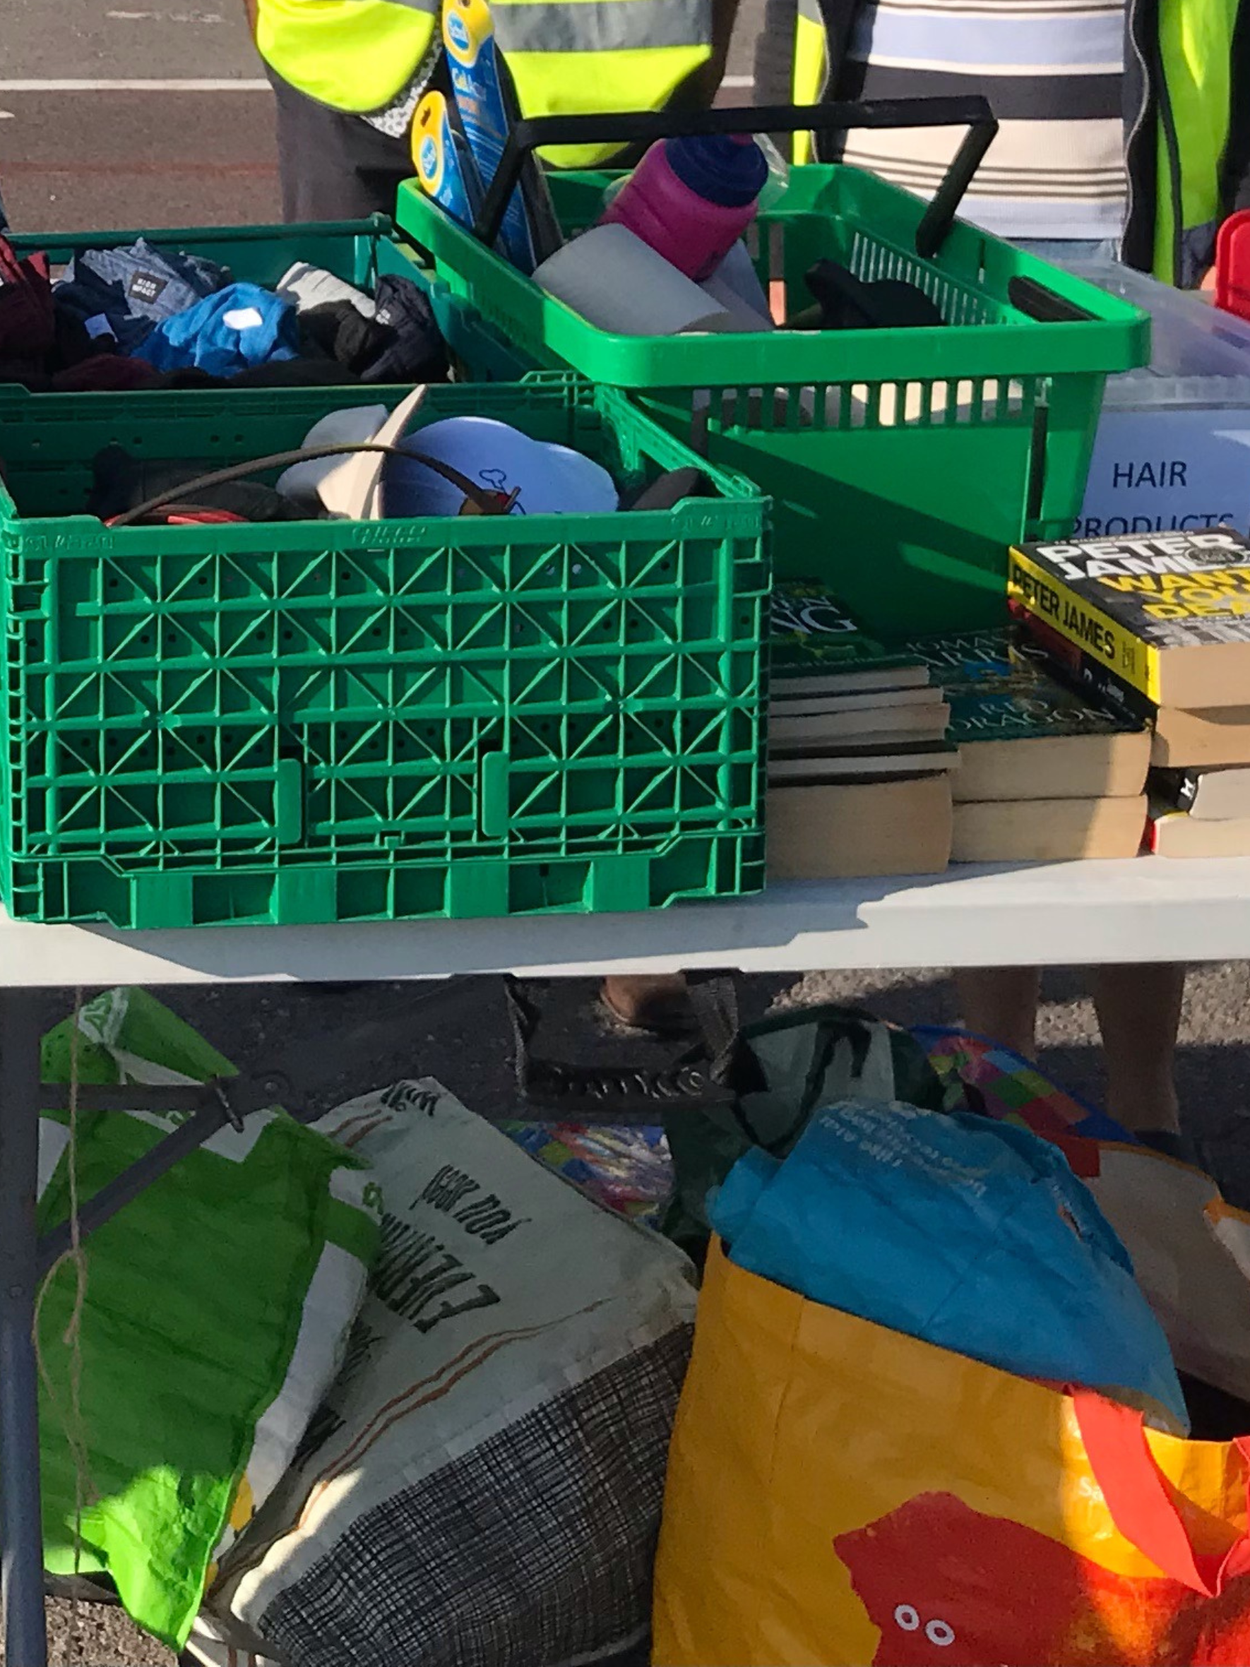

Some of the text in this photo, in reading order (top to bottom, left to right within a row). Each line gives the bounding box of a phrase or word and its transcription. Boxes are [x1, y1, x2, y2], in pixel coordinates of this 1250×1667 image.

[1112, 460, 1188, 488] HAIR
[1036, 533, 1246, 564] PETER
[1058, 550, 1248, 581] JAM
[770, 605, 859, 635] NG
[1013, 564, 1060, 622] PETER
[1062, 600, 1116, 660] JAMES
[947, 707, 1117, 732] DRAGON
